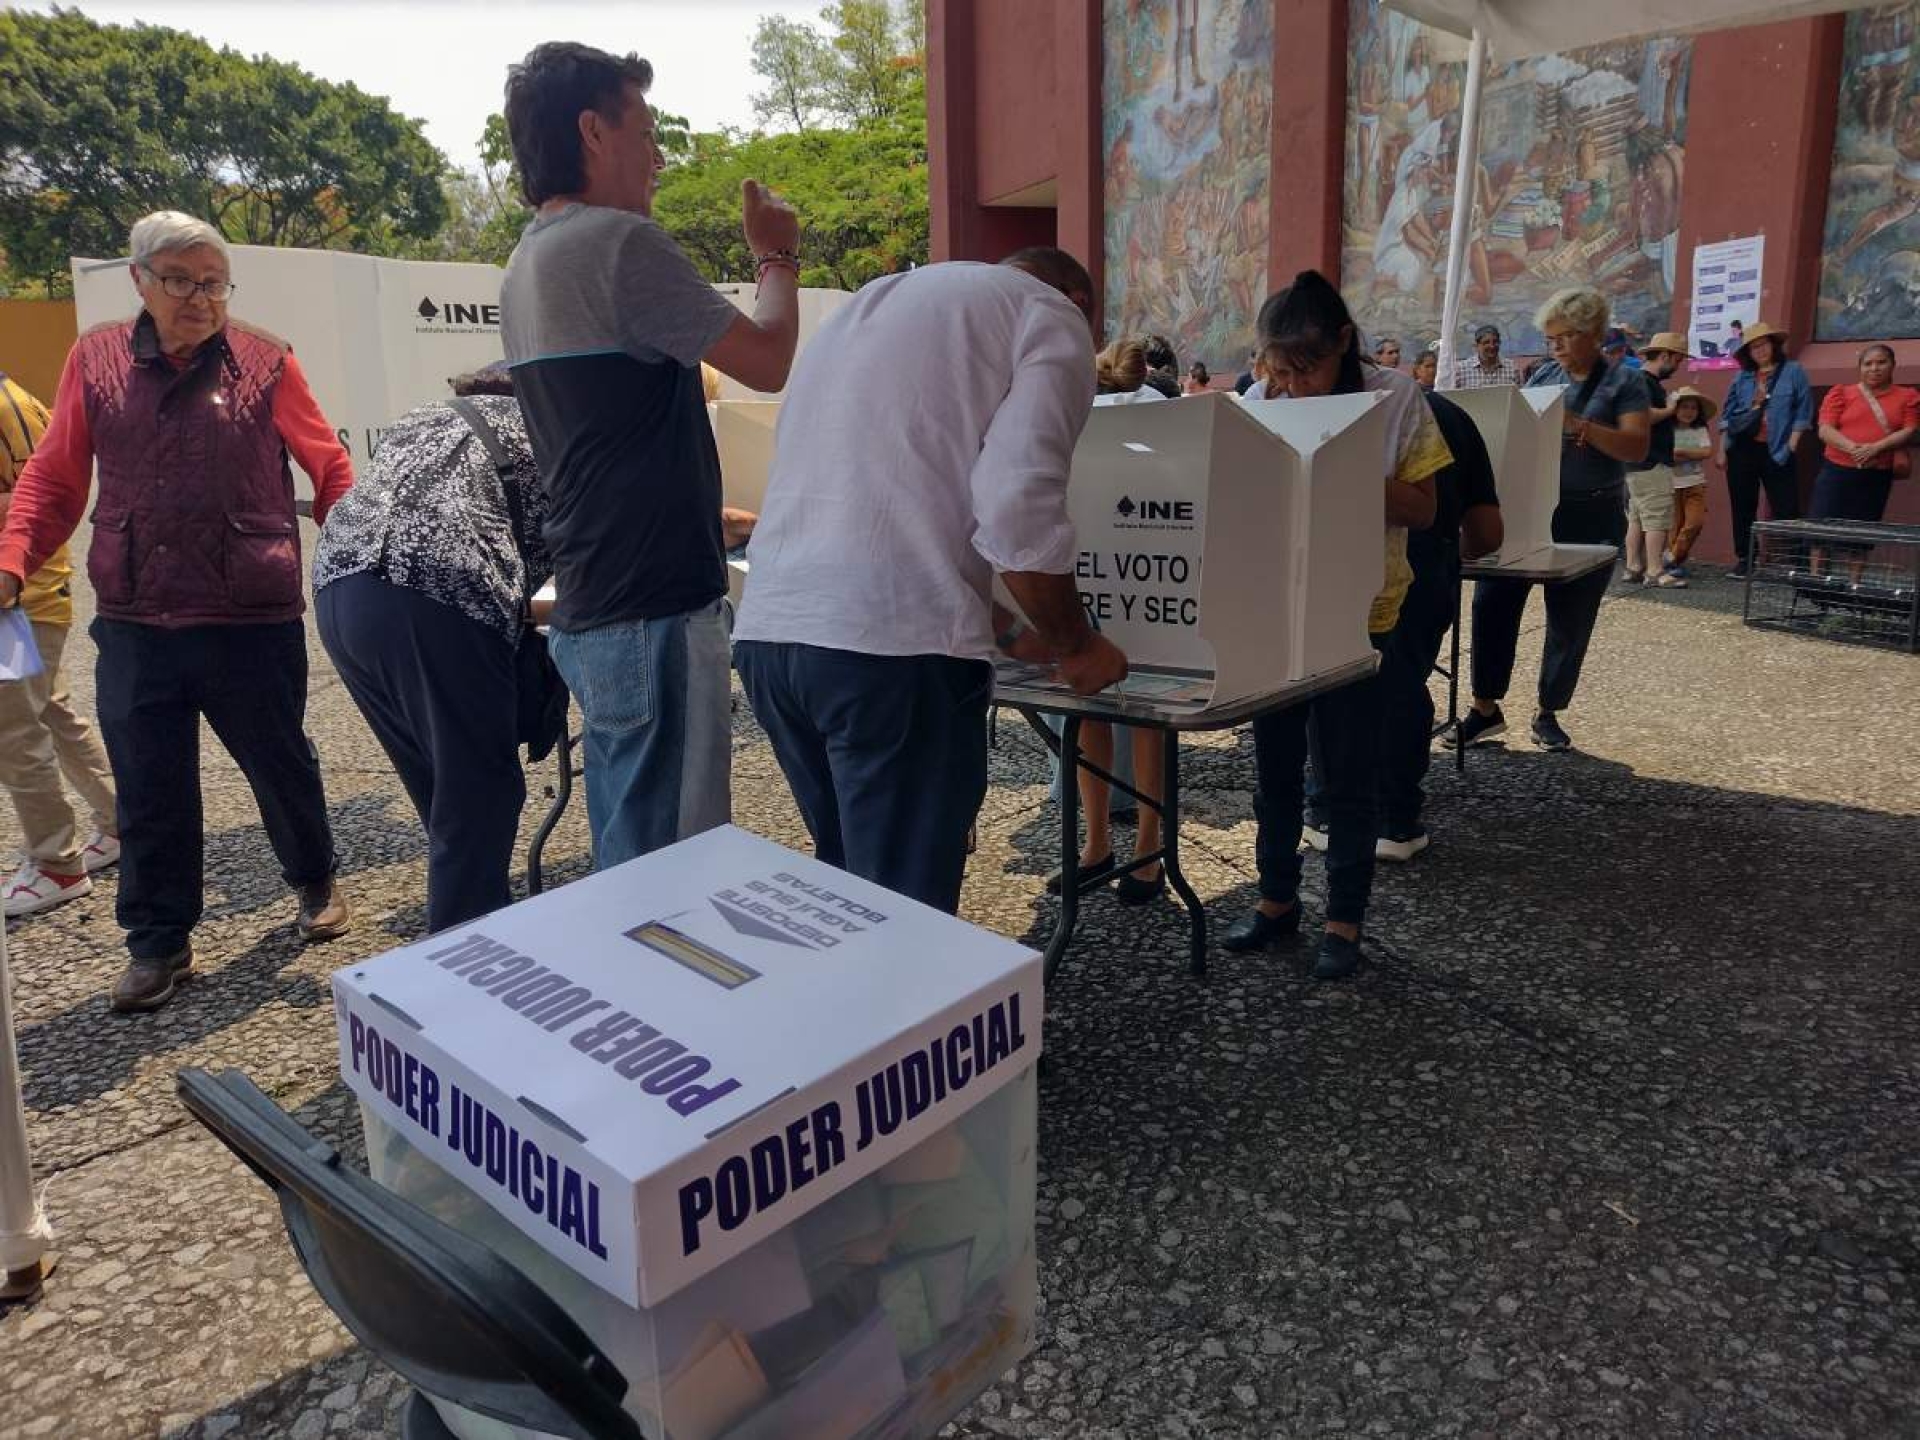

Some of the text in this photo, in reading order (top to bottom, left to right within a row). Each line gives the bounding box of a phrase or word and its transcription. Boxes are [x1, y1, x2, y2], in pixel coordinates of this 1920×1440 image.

[443, 303, 500, 325] INE
[1140, 501, 1193, 520] INE
[1076, 551, 1107, 579] EL
[1114, 552, 1189, 584] VOTO
[1120, 594, 1137, 622] Y
[1144, 596, 1198, 626] SEC
[744, 879, 799, 906] SUS
[772, 871, 889, 924] BOLETAS
[714, 888, 841, 949] DEPOSITE
[425, 933, 743, 1118] PODER JUDICIAL
[349, 1010, 609, 1262] PODER JUDICIAL
[678, 991, 1026, 1257] PODER JUDICIAL
